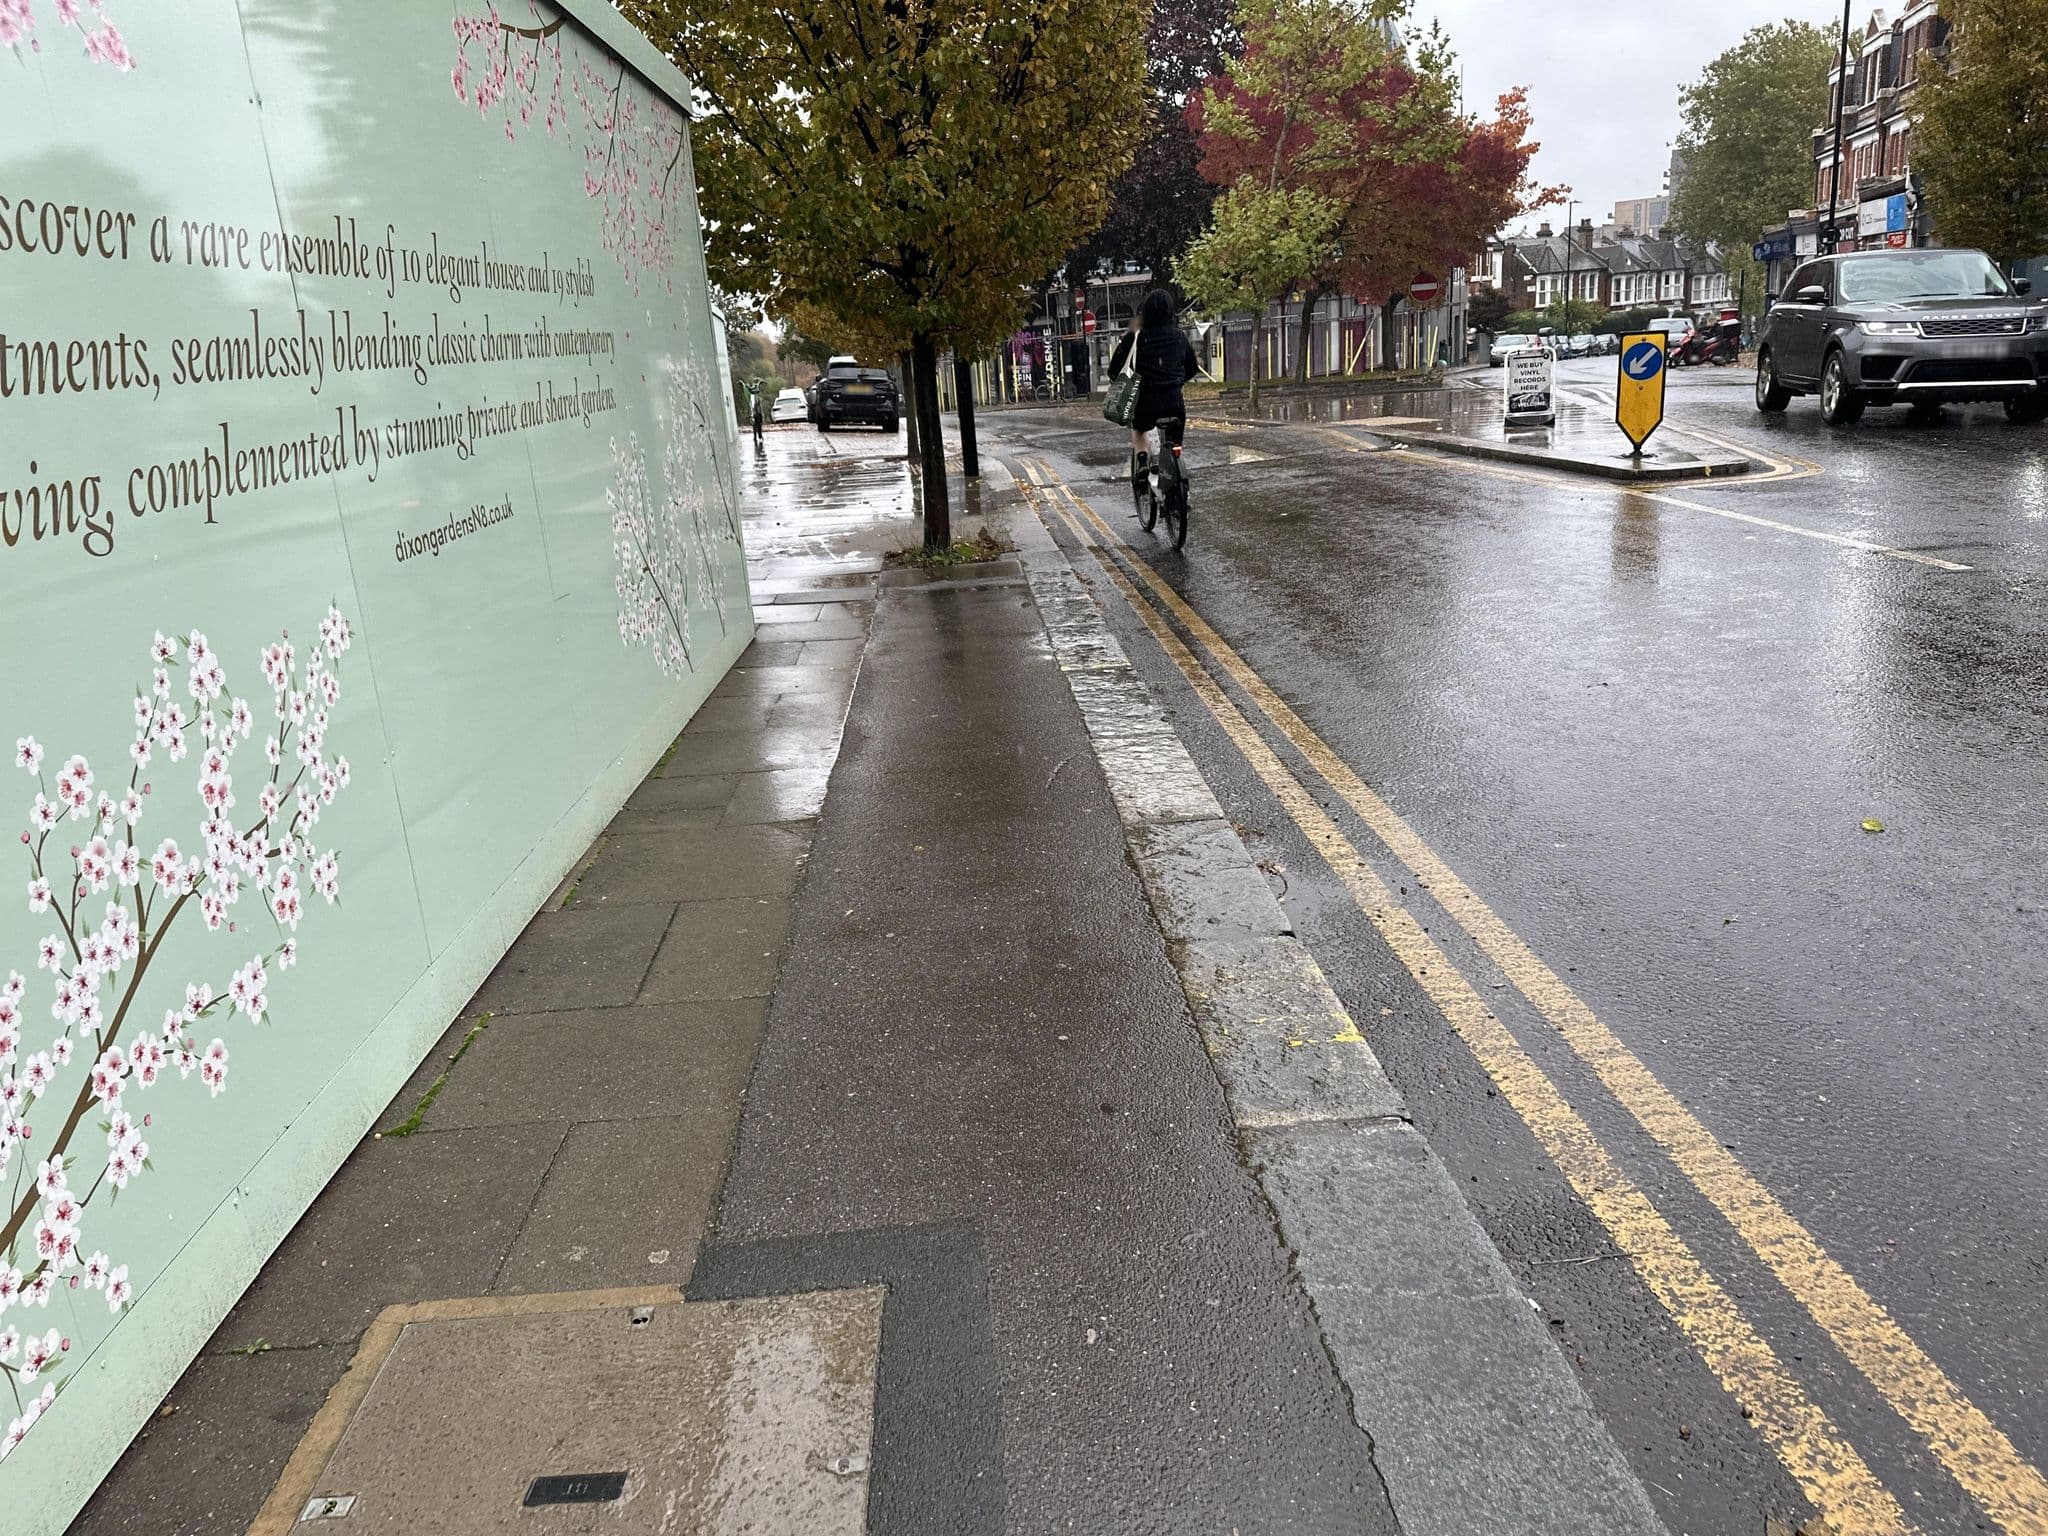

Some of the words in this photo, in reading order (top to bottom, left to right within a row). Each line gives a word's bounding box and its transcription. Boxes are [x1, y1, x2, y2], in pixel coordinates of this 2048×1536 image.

[150, 215, 172, 264] a
[181, 219, 250, 270] rare
[260, 215, 370, 280] ensemble
[376, 223, 395, 299] of
[400, 248, 421, 284] 10
[426, 232, 480, 304] elegant
[482, 241, 525, 293] houses
[528, 251, 550, 294] and
[552, 269, 564, 305] 19
[565, 257, 595, 307] stylish
[171, 308, 324, 396] seamlessly
[328, 310, 427, 386] blending
[427, 313, 477, 366] classic
[480, 314, 523, 362] charm
[524, 315, 552, 359] with
[554, 327, 616, 366] contemporary
[1513, 376, 1546, 384] RECORDS
[128, 407, 348, 525] complemented
[350, 406, 380, 482] by
[386, 401, 467, 460] stunning
[467, 396, 517, 456] private
[520, 381, 544, 428] and
[545, 377, 580, 422] shared
[395, 493, 514, 562] dixongardensN8.co.uk
